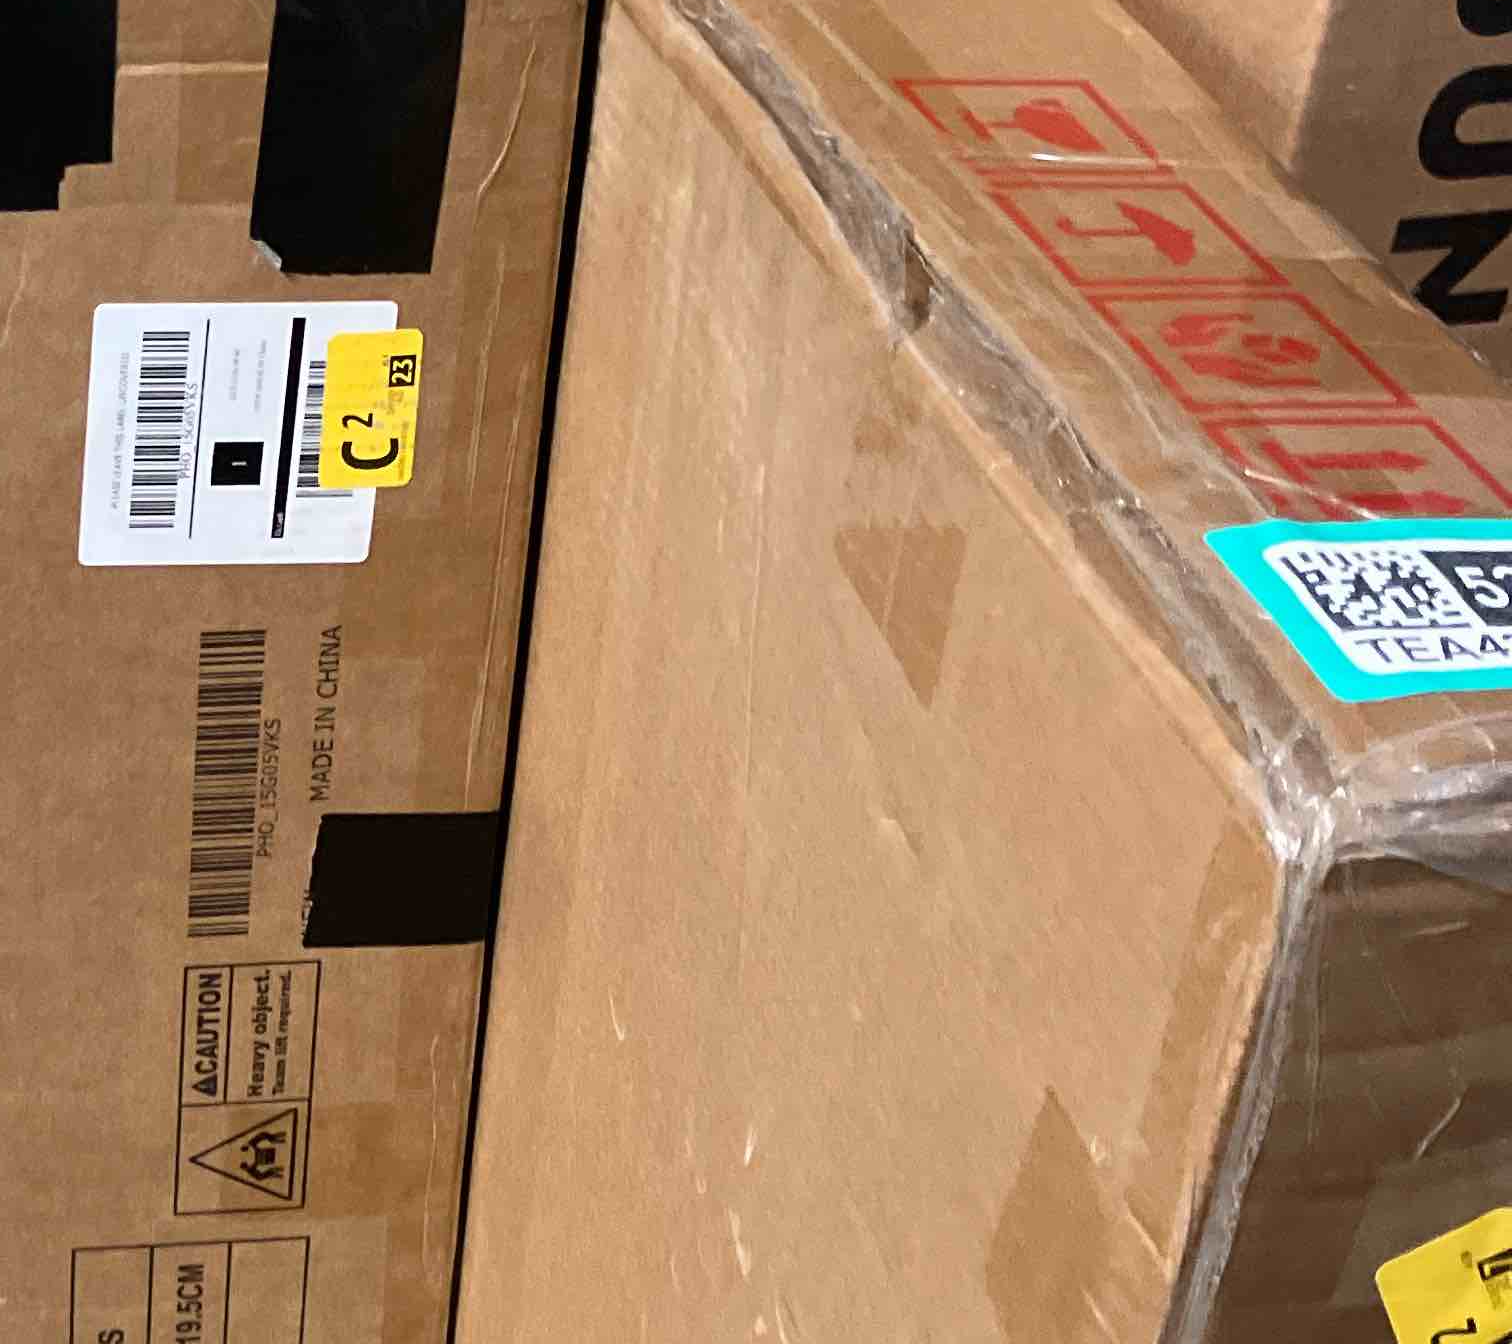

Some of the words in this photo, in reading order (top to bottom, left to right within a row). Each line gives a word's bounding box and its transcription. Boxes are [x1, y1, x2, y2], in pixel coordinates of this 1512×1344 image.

[391, 359, 414, 385] 23
[342, 412, 374, 429] 2
[340, 437, 399, 471] C
[316, 624, 343, 700] CHINA
[314, 706, 336, 733] IN
[309, 736, 333, 802] MADE
[194, 973, 222, 1075] CAUTION
[251, 969, 272, 1035] object.
[247, 1040, 270, 1097] Heavy
[175, 1264, 205, 1344] 19.5CM
